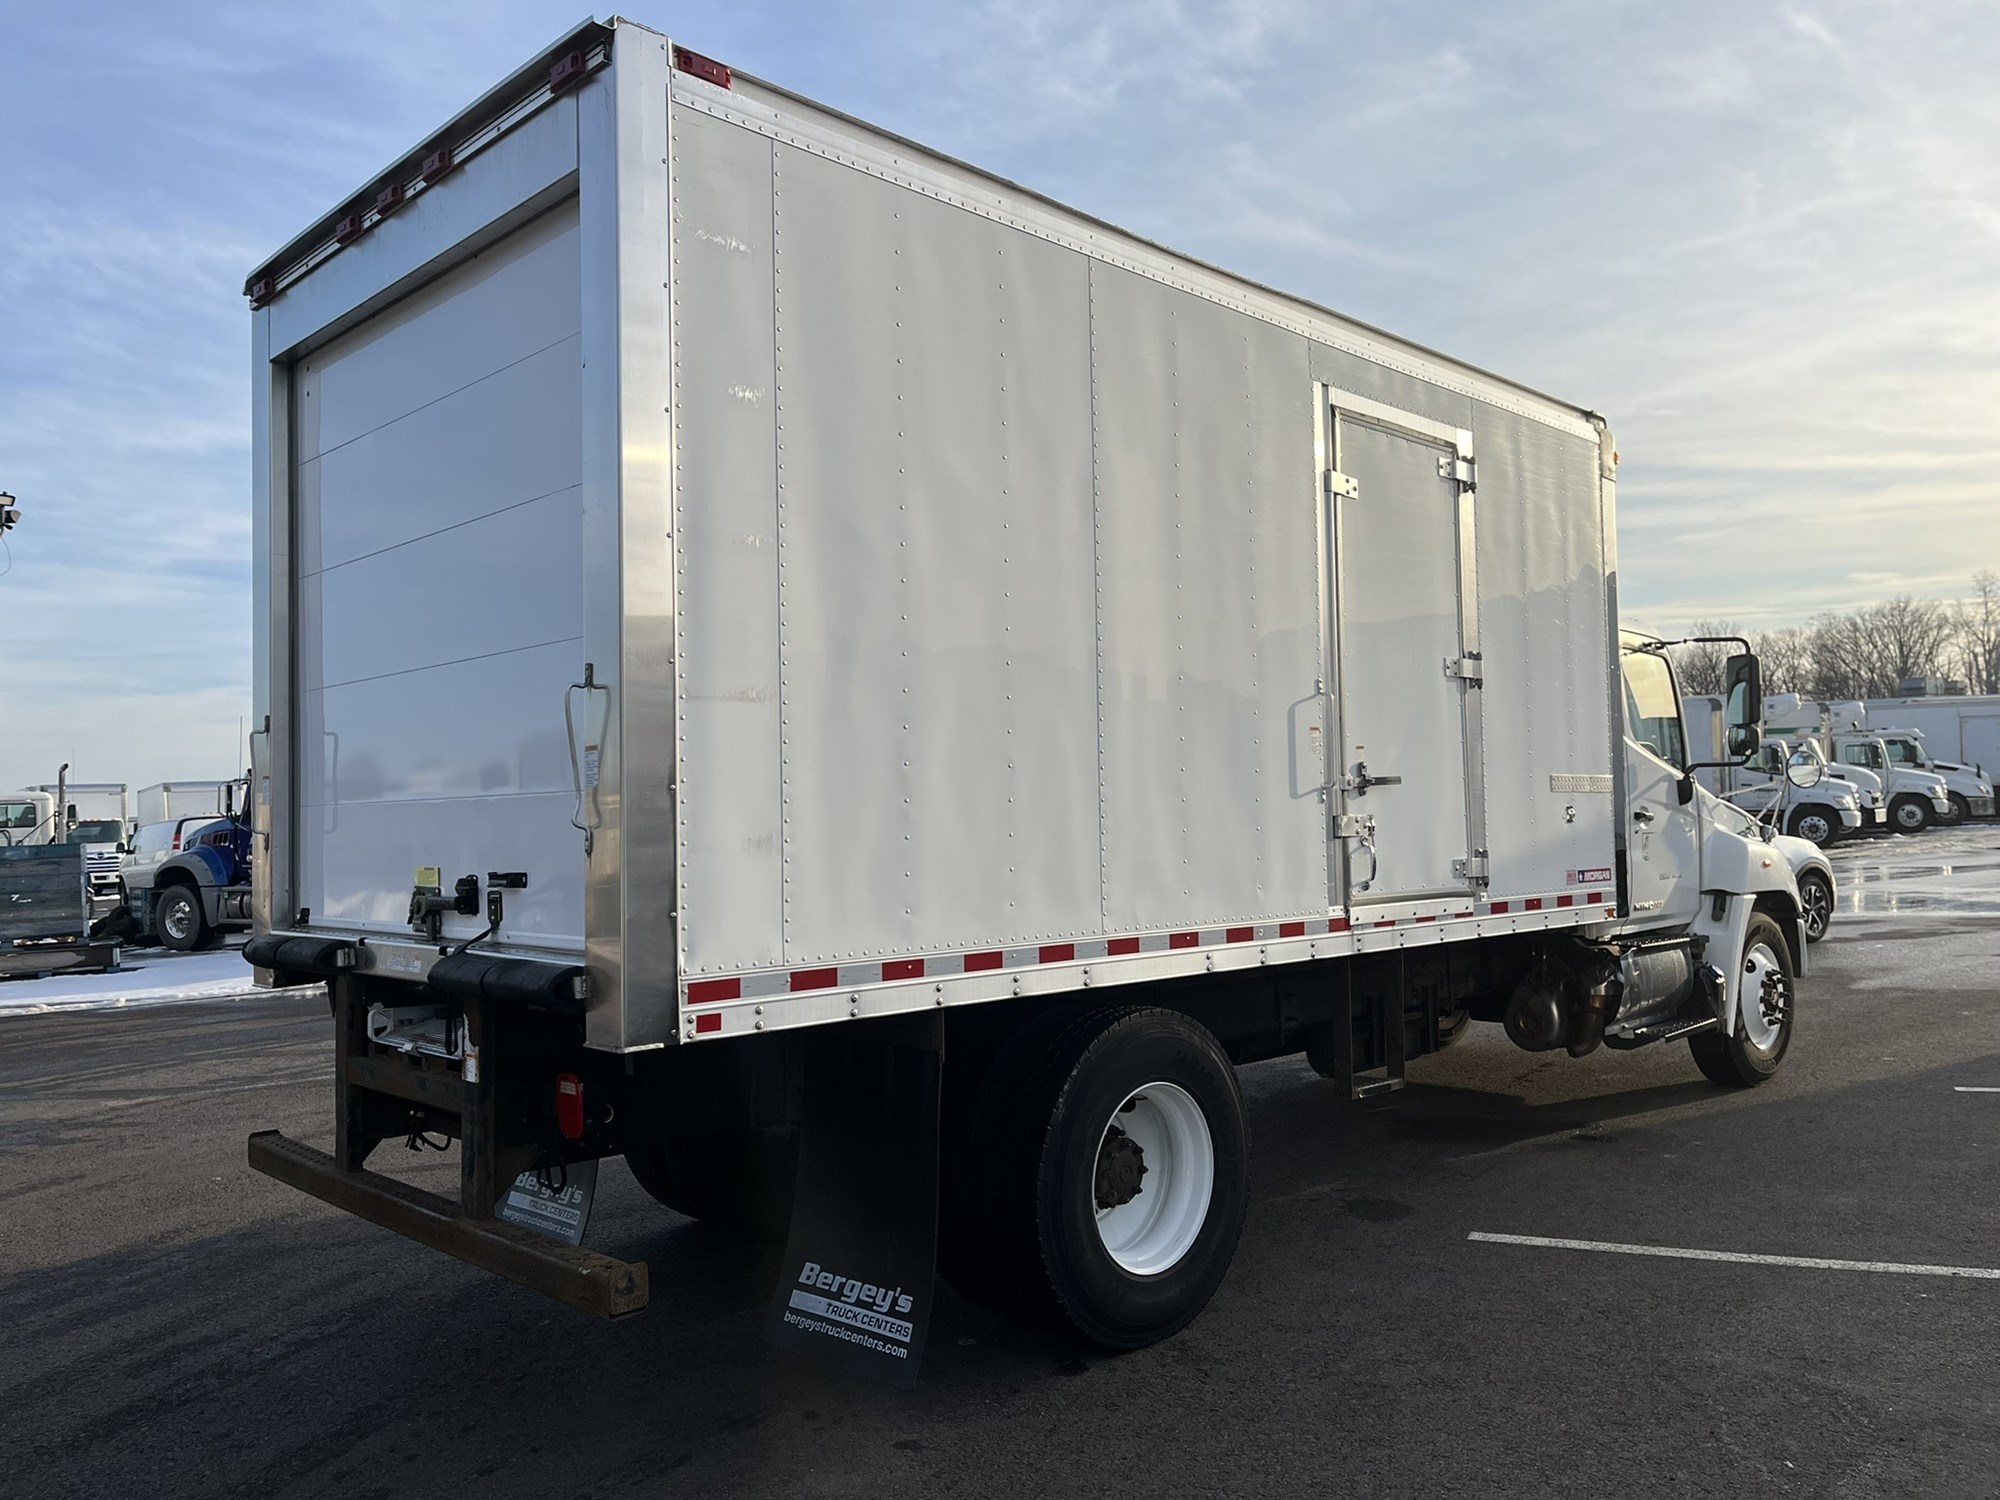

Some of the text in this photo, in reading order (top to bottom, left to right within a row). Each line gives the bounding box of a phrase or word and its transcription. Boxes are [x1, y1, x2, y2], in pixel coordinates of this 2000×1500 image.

[515, 1171, 584, 1204] Bergy's
[529, 1199, 549, 1213] TRUCK
[798, 1261, 914, 1313] Bergey's
[783, 1310, 908, 1359] bergeystruckcenters.com
[825, 1302, 911, 1338] TRUCK CENTERS
